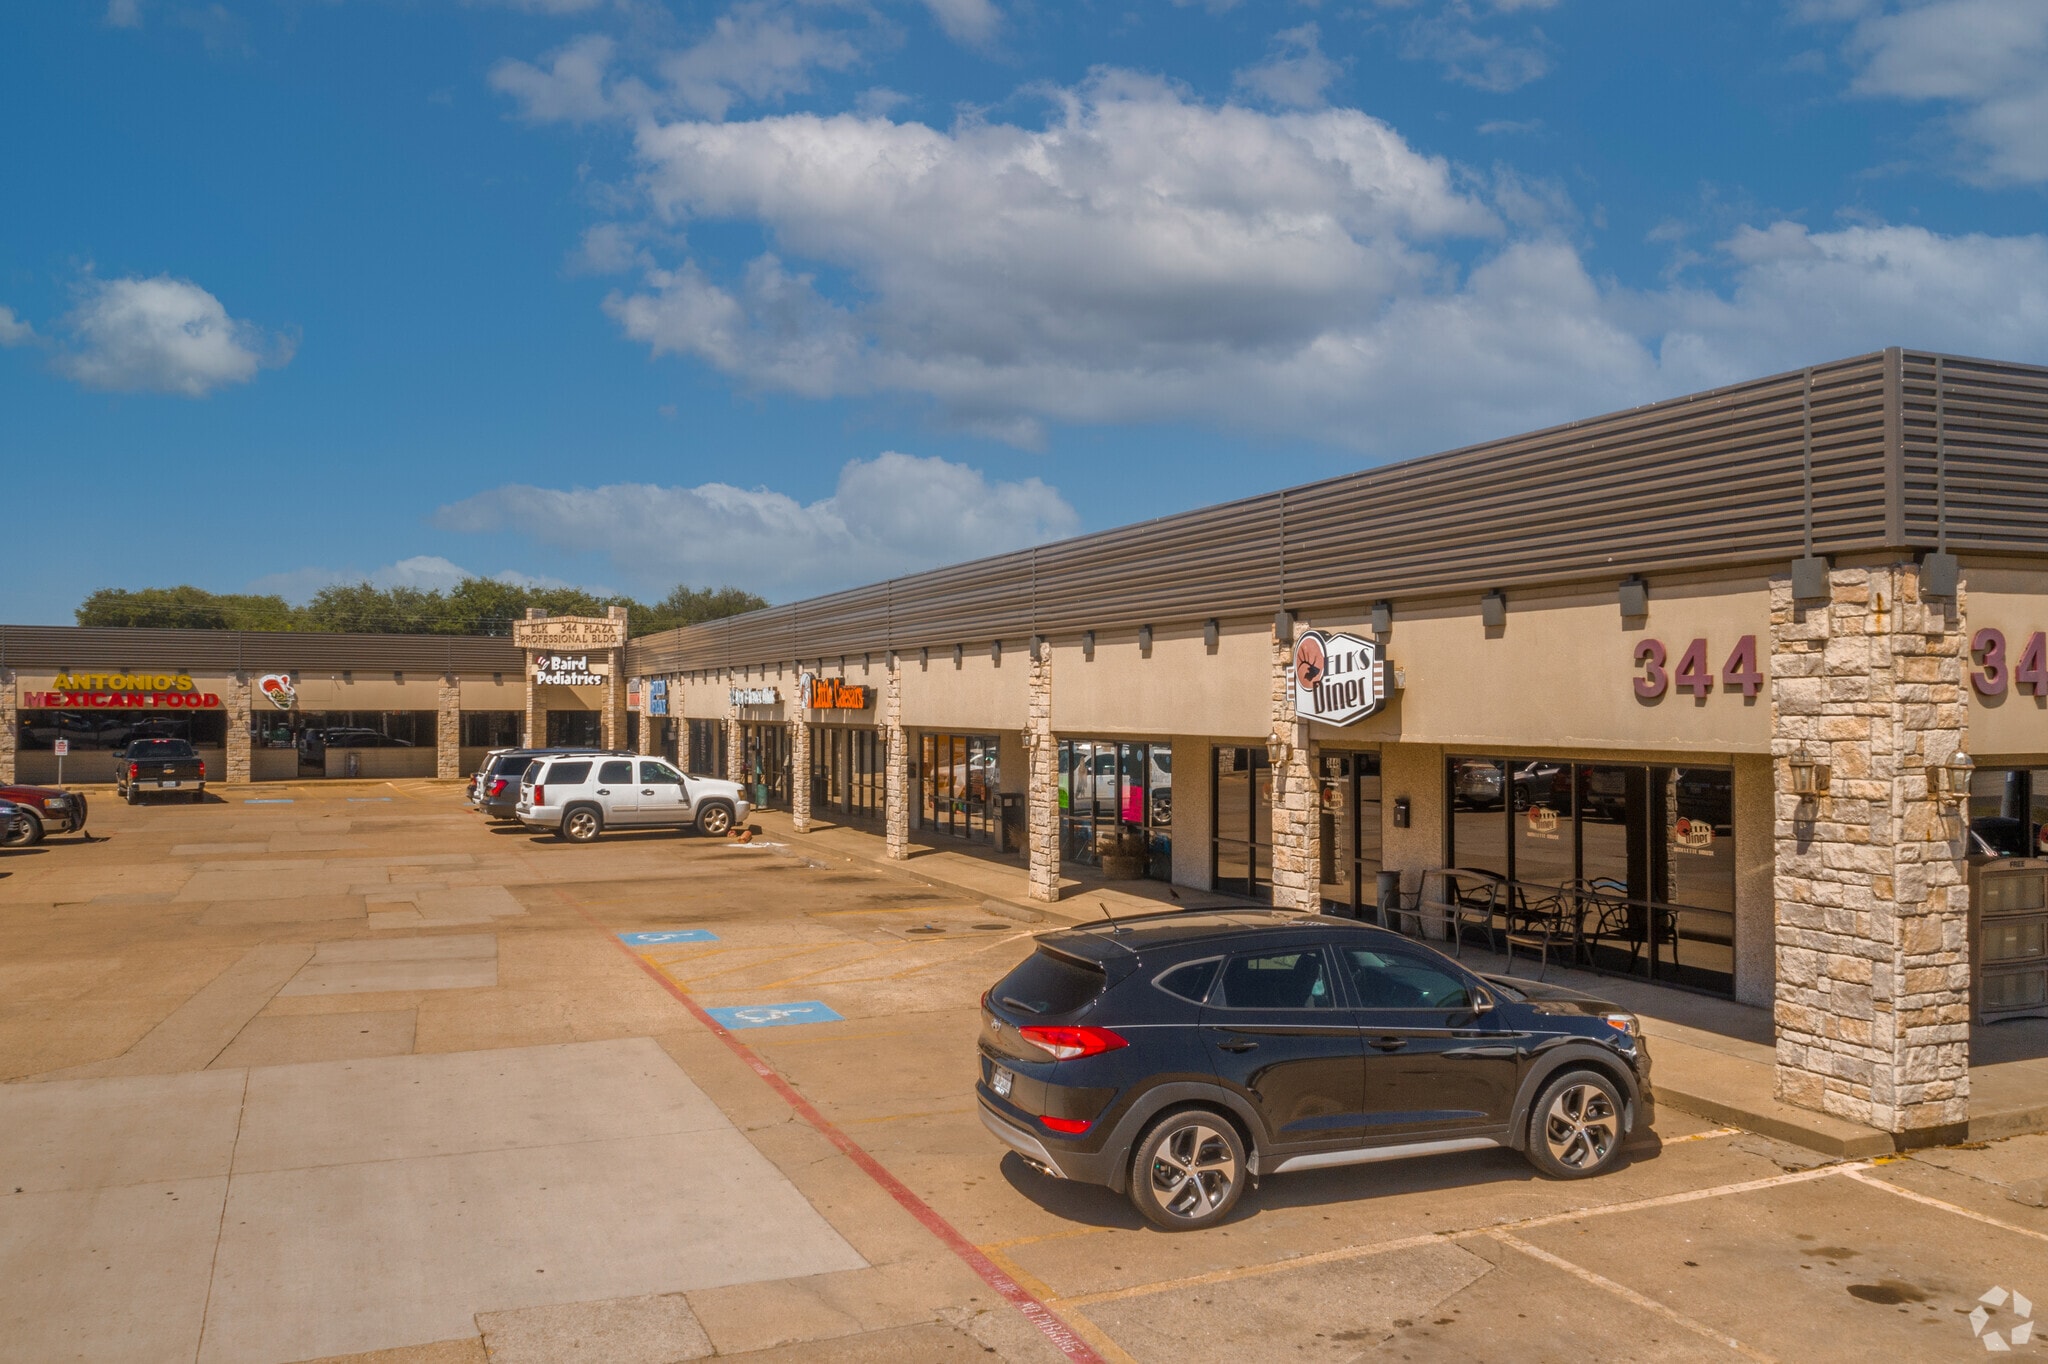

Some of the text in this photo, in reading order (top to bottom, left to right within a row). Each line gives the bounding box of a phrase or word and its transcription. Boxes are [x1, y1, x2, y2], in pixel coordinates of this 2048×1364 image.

[531, 623, 615, 634] ELK 344 PLAZA
[520, 635, 588, 643] PROFESSIONAL
[551, 656, 587, 670] Baird
[1324, 648, 1371, 676] ELKS
[1633, 634, 1763, 698] 344
[52, 673, 193, 691] ANTONIO'S
[536, 671, 602, 685] Pediatrics
[23, 691, 219, 709] MEXICAN FOOD
[812, 678, 833, 709] Little
[1313, 677, 1366, 714] Diner
[1685, 832, 1708, 844] Diner
[1021, 1301, 1084, 1353] NO PARKING
